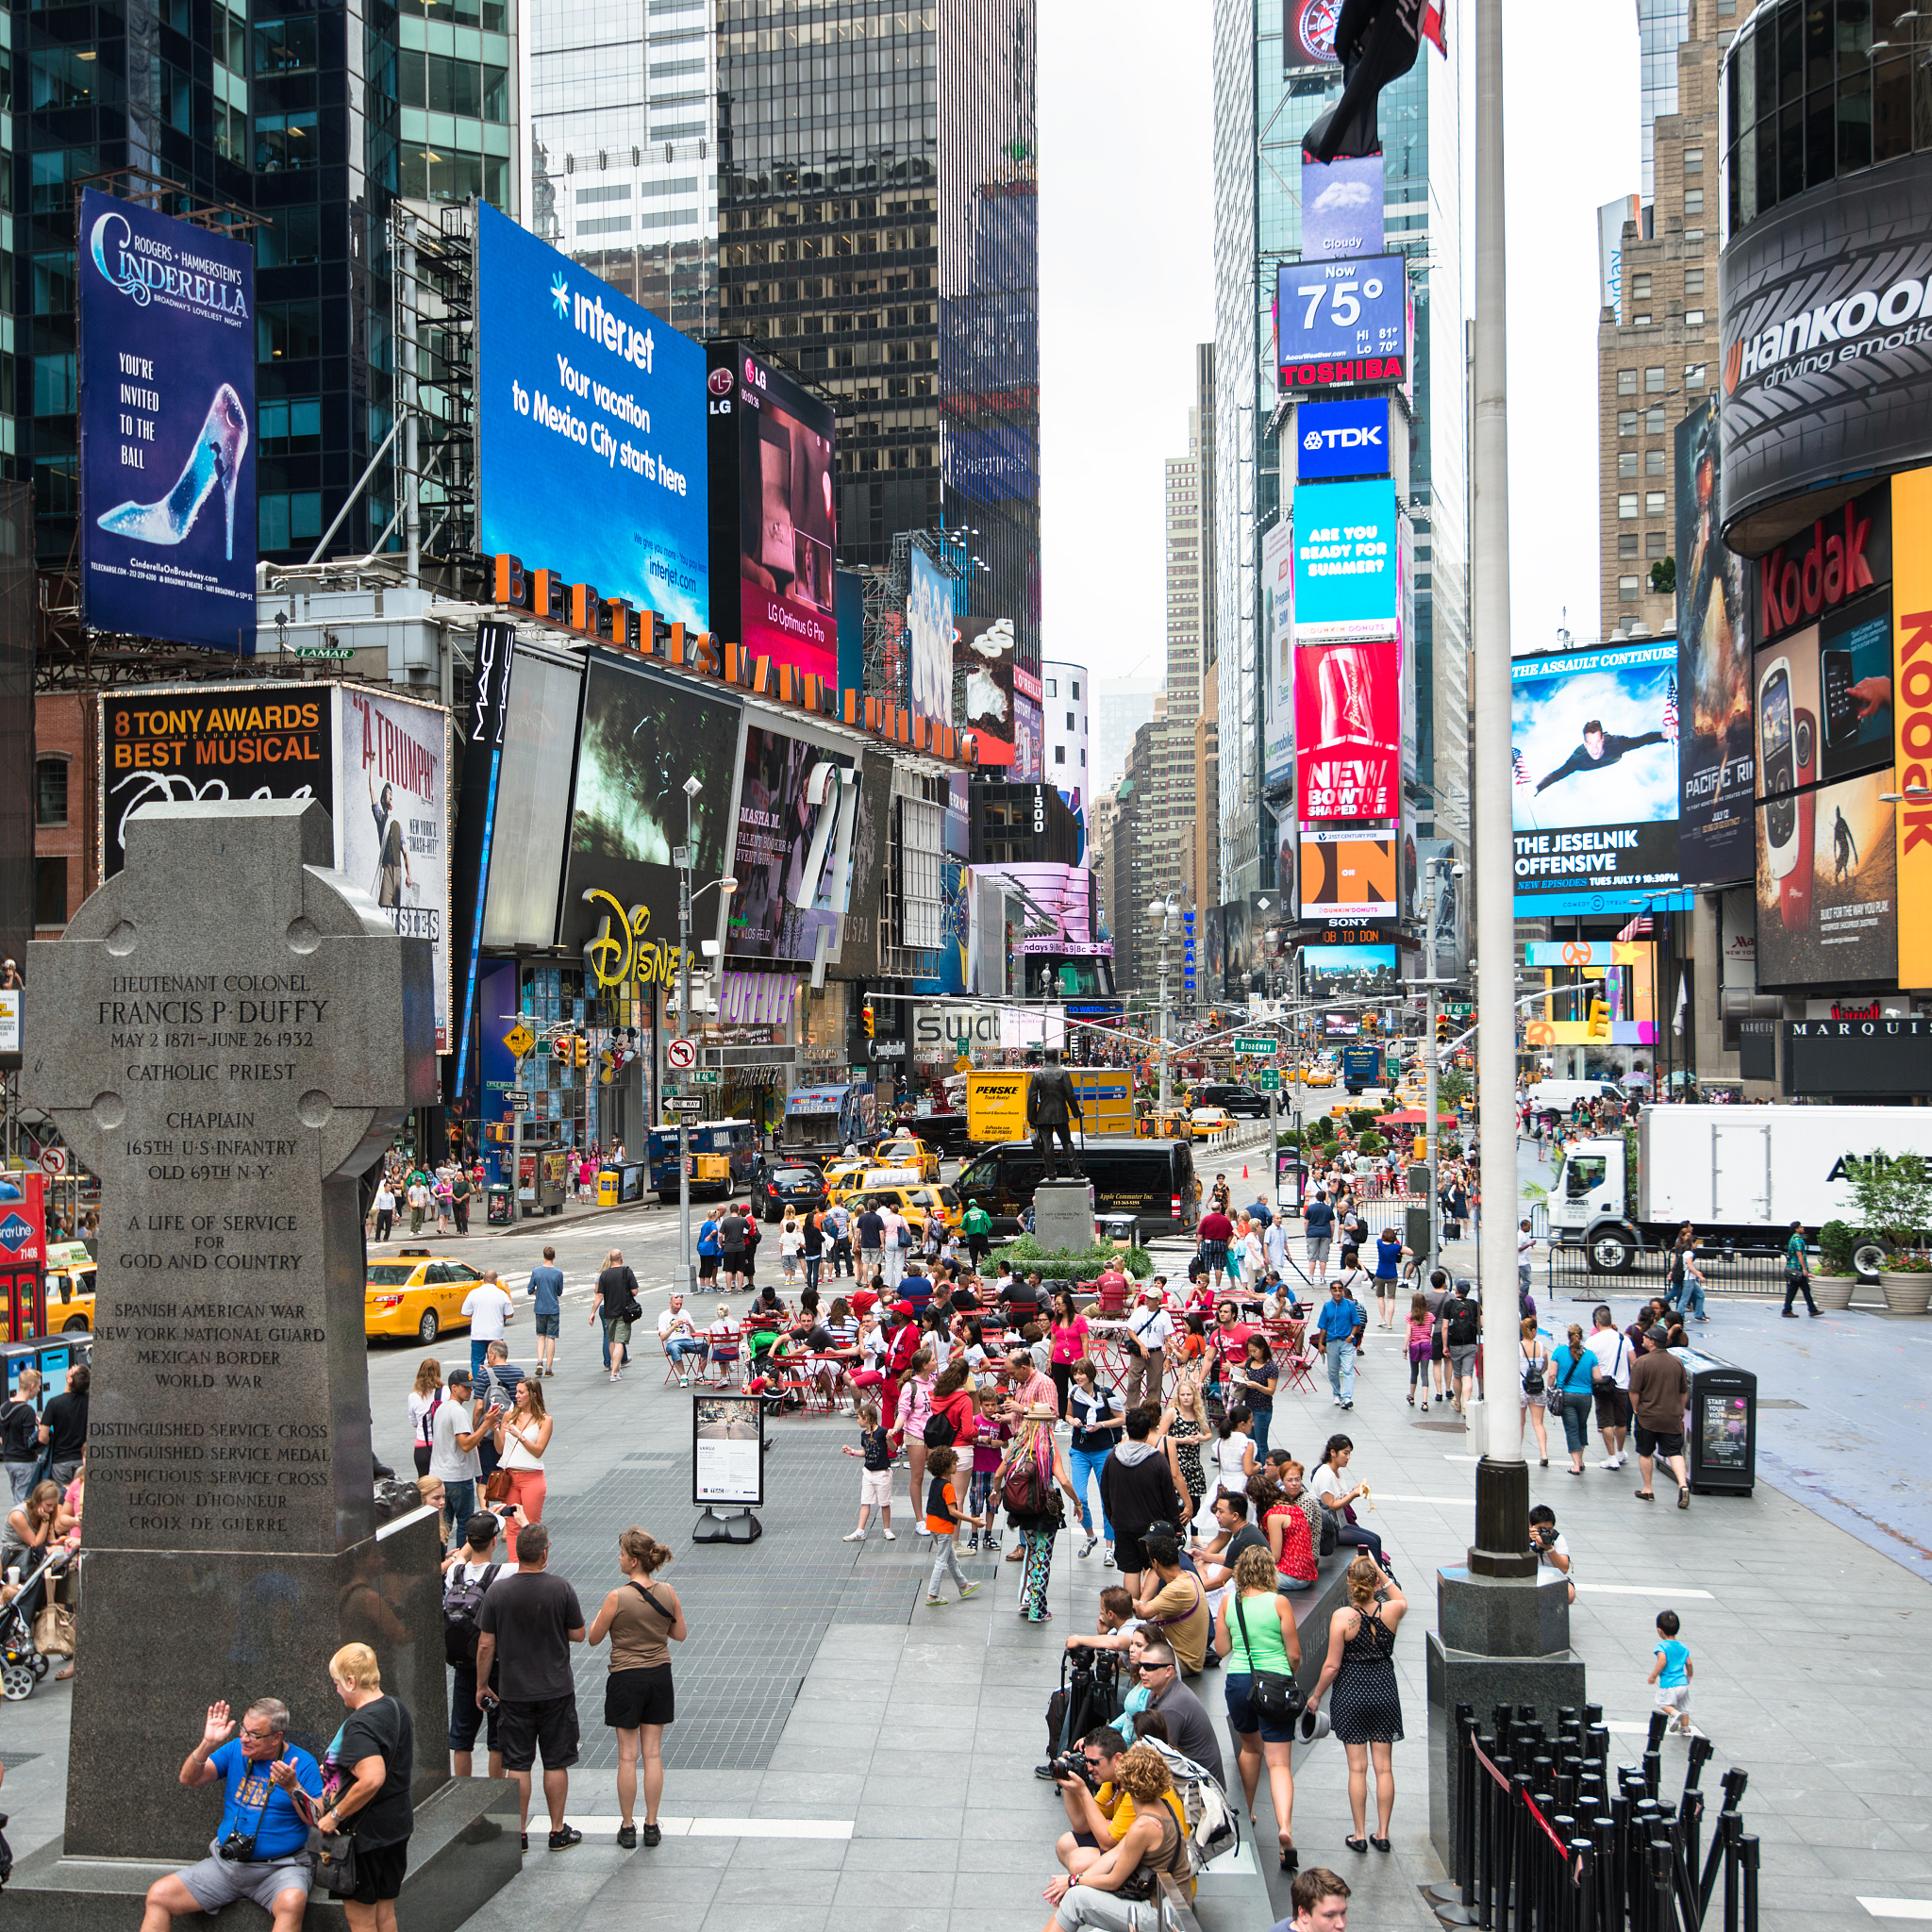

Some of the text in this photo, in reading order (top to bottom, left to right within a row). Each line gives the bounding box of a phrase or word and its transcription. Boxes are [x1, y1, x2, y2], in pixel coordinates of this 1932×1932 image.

[1323, 237, 1363, 249] Cloudy
[91, 212, 249, 319] CINDERELLA
[134, 235, 242, 286] RODGERS HAMMERSTEIN'S
[1325, 266, 1356, 278] Now
[153, 293, 242, 328] BROADWAY'S LOVELIEST NIGHT
[1297, 278, 1383, 330] 75°
[1357, 327, 1398, 341] Hi 81°
[1285, 350, 1347, 362] AccuWeather.com
[1357, 341, 1398, 355] Lo 70°
[119, 352, 154, 381] YOU'RE
[1281, 358, 1403, 386] TOSHIBA
[1763, 350, 1834, 391] driving
[755, 366, 767, 391] LG
[120, 383, 159, 412] INVITED
[557, 353, 651, 434] Your vacation
[709, 399, 731, 415] LG
[119, 413, 155, 441] TO THE
[512, 379, 687, 496] to Mexico City starts here
[1322, 426, 1383, 448] TDK
[121, 444, 145, 470] BALL
[1309, 525, 1377, 542] ARE YOU
[1300, 545, 1352, 560] READY
[1356, 542, 1387, 556] FOR
[129, 558, 218, 584] CinderellaOnBroadway.com
[649, 557, 696, 593] interjet.com
[1307, 558, 1385, 577] SUMMER?
[1761, 500, 1874, 638] Kodak
[768, 602, 825, 642] LG Optimus G Pro
[1309, 624, 1385, 635] DUNKIN' DONUTS
[299, 648, 349, 658] LAMAR
[495, 553, 978, 767] BERTELSMANN BUILDING
[1511, 645, 1677, 678] THE ASSAULT CONTINUES
[1019, 677, 1042, 699] O'REILLY
[115, 703, 320, 737] 8 TONY AWARDS
[175, 731, 258, 741] INCLUDING
[1265, 731, 1292, 760] Lycamobile
[115, 736, 320, 768] BEST MUSICAL
[1307, 759, 1388, 789] NEW
[1686, 768, 1731, 799] PACIFIC
[1307, 787, 1387, 806] BOWTIE
[740, 807, 781, 829] MASHA M.
[1307, 804, 1357, 817] SHAPED
[409, 818, 437, 838] NEW YORK'S
[738, 831, 792, 854] TALENT BOOKER &
[1514, 829, 1639, 854] THE JESELNIK
[736, 848, 774, 867] EVENT GURU
[1514, 853, 1617, 875] OFFENSIVE
[1517, 873, 1678, 890] NEW EPISODES TUES JULY 9 10:30PM
[744, 928, 771, 941] LOS FELIZ
[1342, 931, 1355, 941] TO
[113, 974, 310, 993] LIEUTENANT COLONEL
[719, 972, 797, 1024] FOREVER
[98, 1001, 204, 1024] FRANCIS
[239, 1000, 329, 1024] DUFFY
[1446, 1005, 1452, 1013] W
[1454, 1005, 1463, 1014] 46
[1740, 1023, 1774, 1033] MARQUIS
[1241, 1041, 1272, 1052] Broadway
[126, 1063, 297, 1081] CATHOLIC PRIEST
[695, 1073, 700, 1081] W
[701, 1073, 709, 1081] 46
[975, 1086, 1019, 1094] PENSKE
[791, 1105, 837, 1113] LIBERTY
[166, 1112, 255, 1128] CHAPLAIN
[713, 1131, 730, 1148] GARDA
[128, 1215, 298, 1231] A LIFE OF SERVICE
[194, 1236, 225, 1248] FOR
[119, 1254, 303, 1271] GOD AND COUNTRY
[115, 1304, 305, 1319] SPANISH AMERICAN WAR
[93, 1326, 325, 1342] NEW YORK NATIONAL GUARD
[89, 1423, 328, 1439] DISTINGUISHED SERVICE CROSS
[129, 1516, 288, 1532] CROIX DE GUERRE
